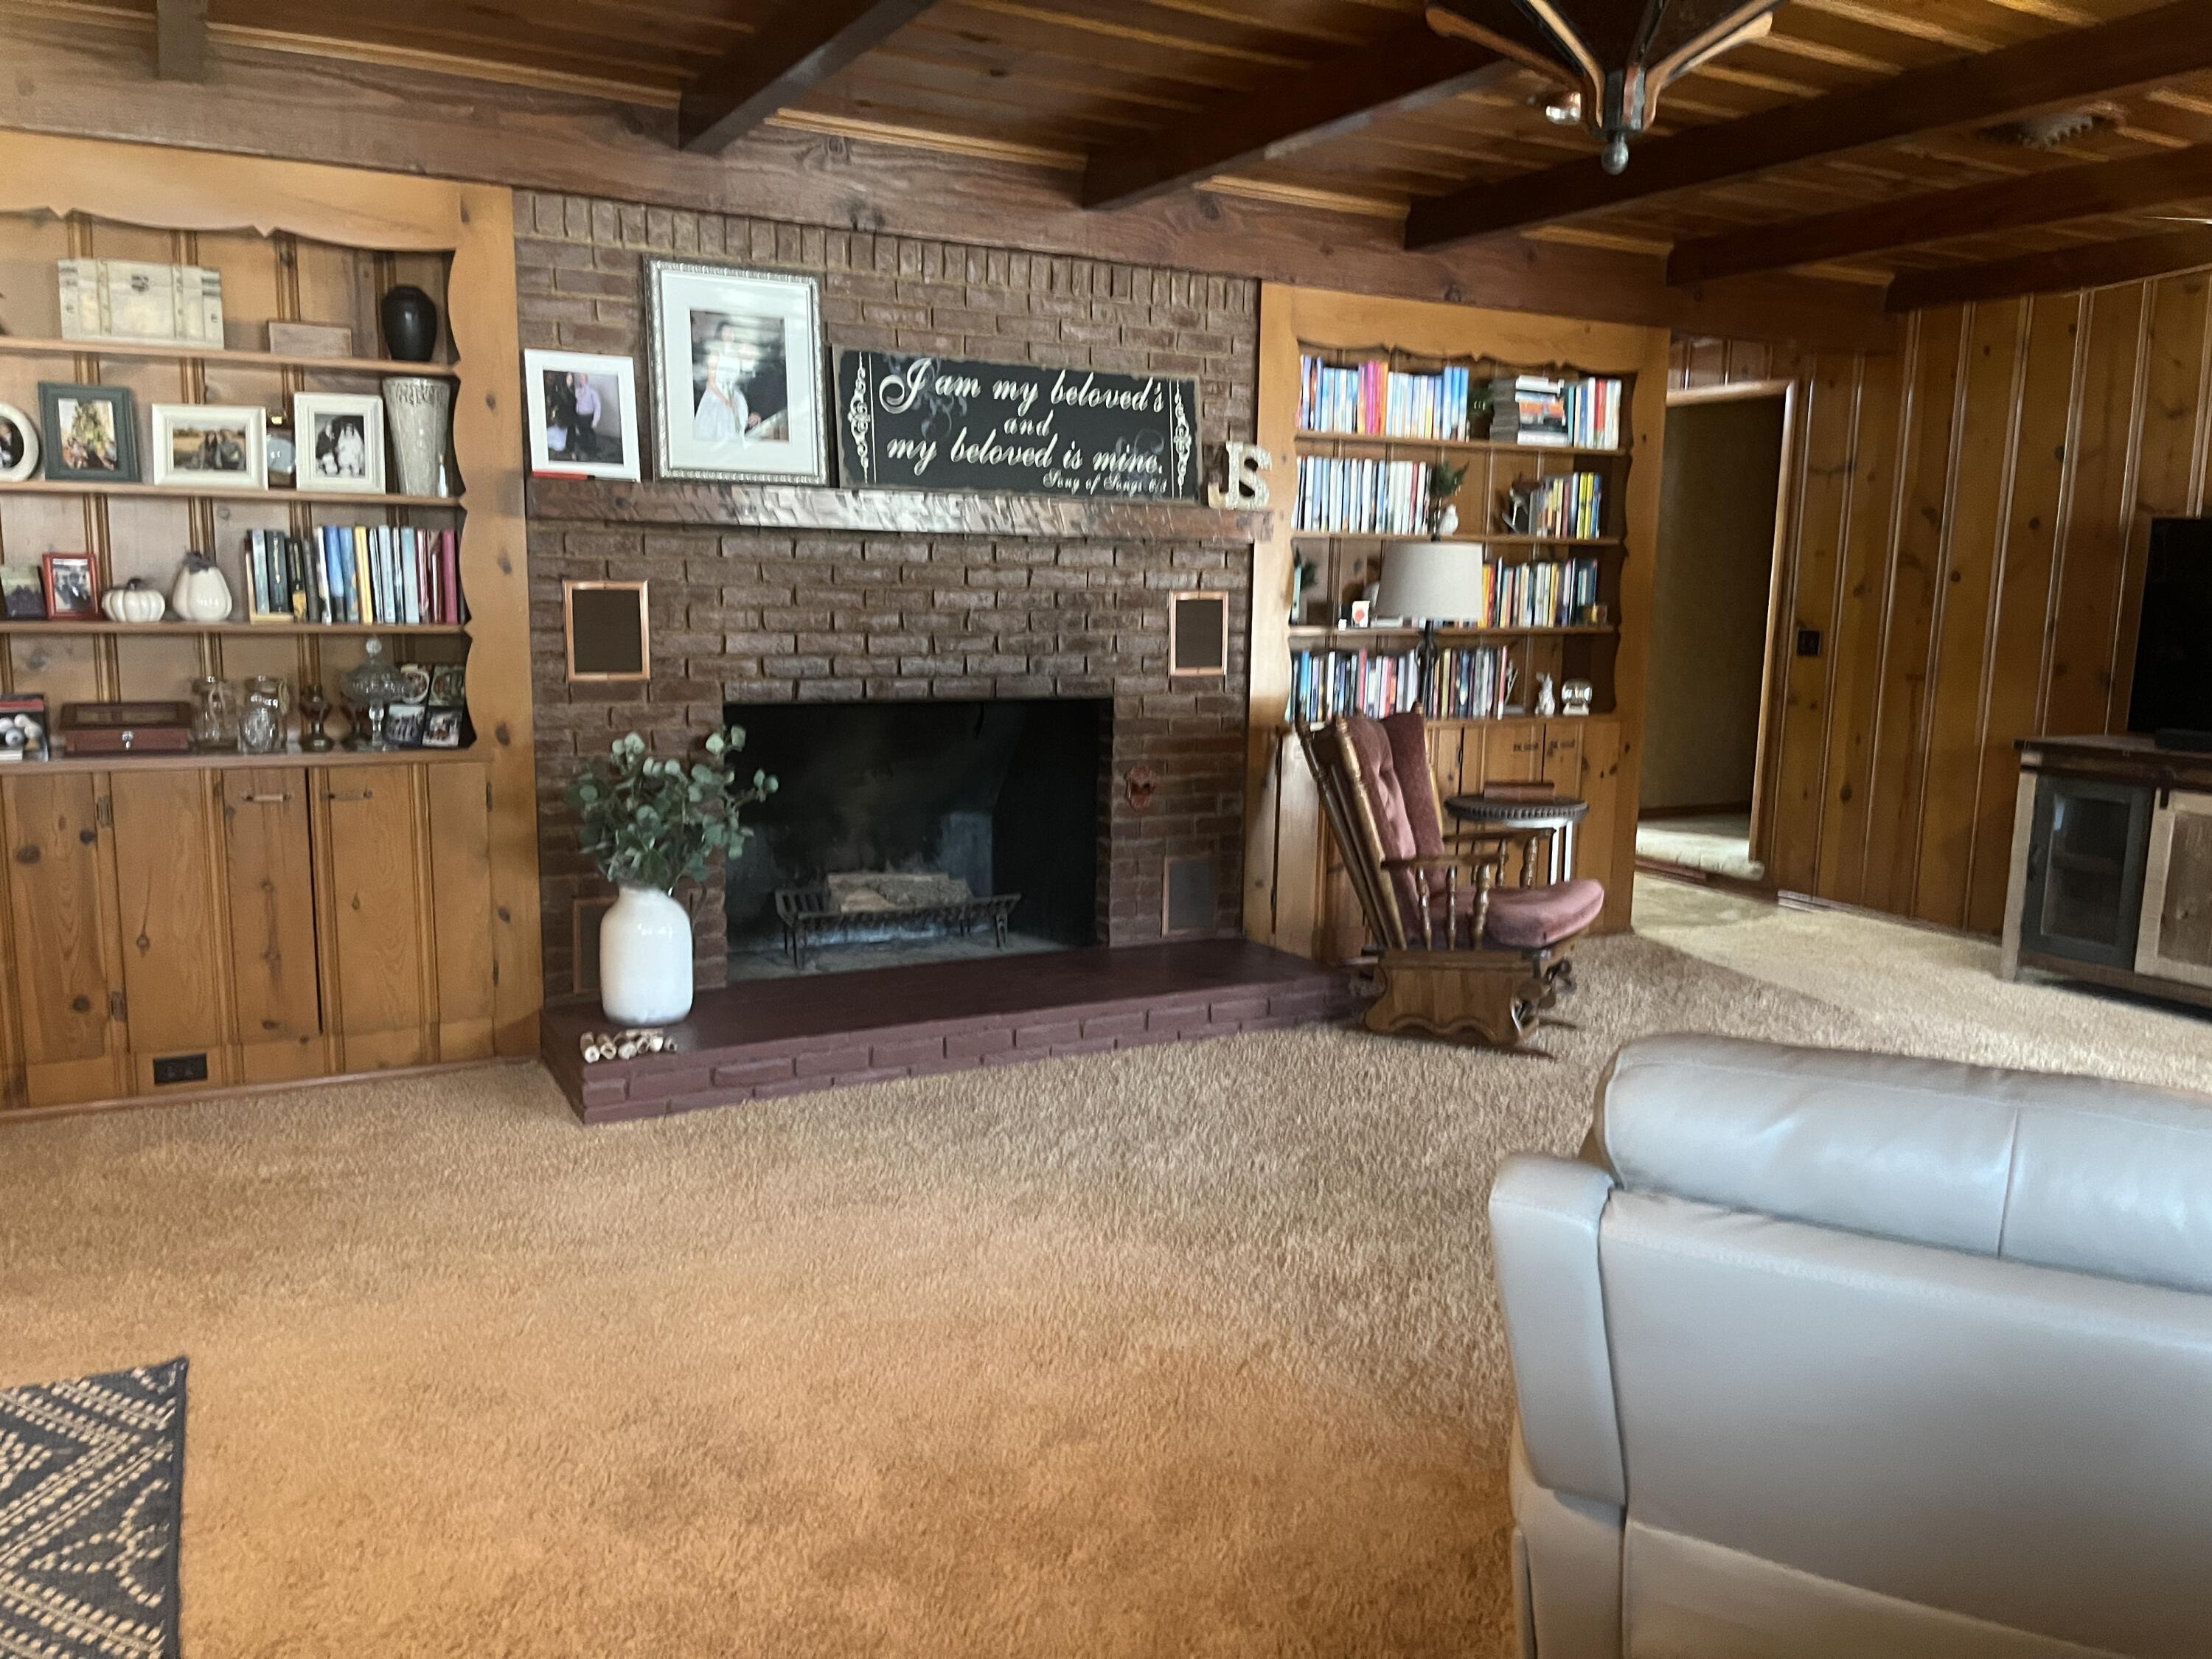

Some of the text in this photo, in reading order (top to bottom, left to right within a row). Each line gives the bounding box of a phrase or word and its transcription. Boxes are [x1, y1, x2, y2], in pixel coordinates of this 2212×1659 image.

[879, 358, 1164, 417] I am my beloved's
[1004, 409, 1054, 437] and
[887, 426, 1163, 476] my beloved is mine.
[1043, 468, 1080, 495] Song
[1085, 473, 1102, 495] of
